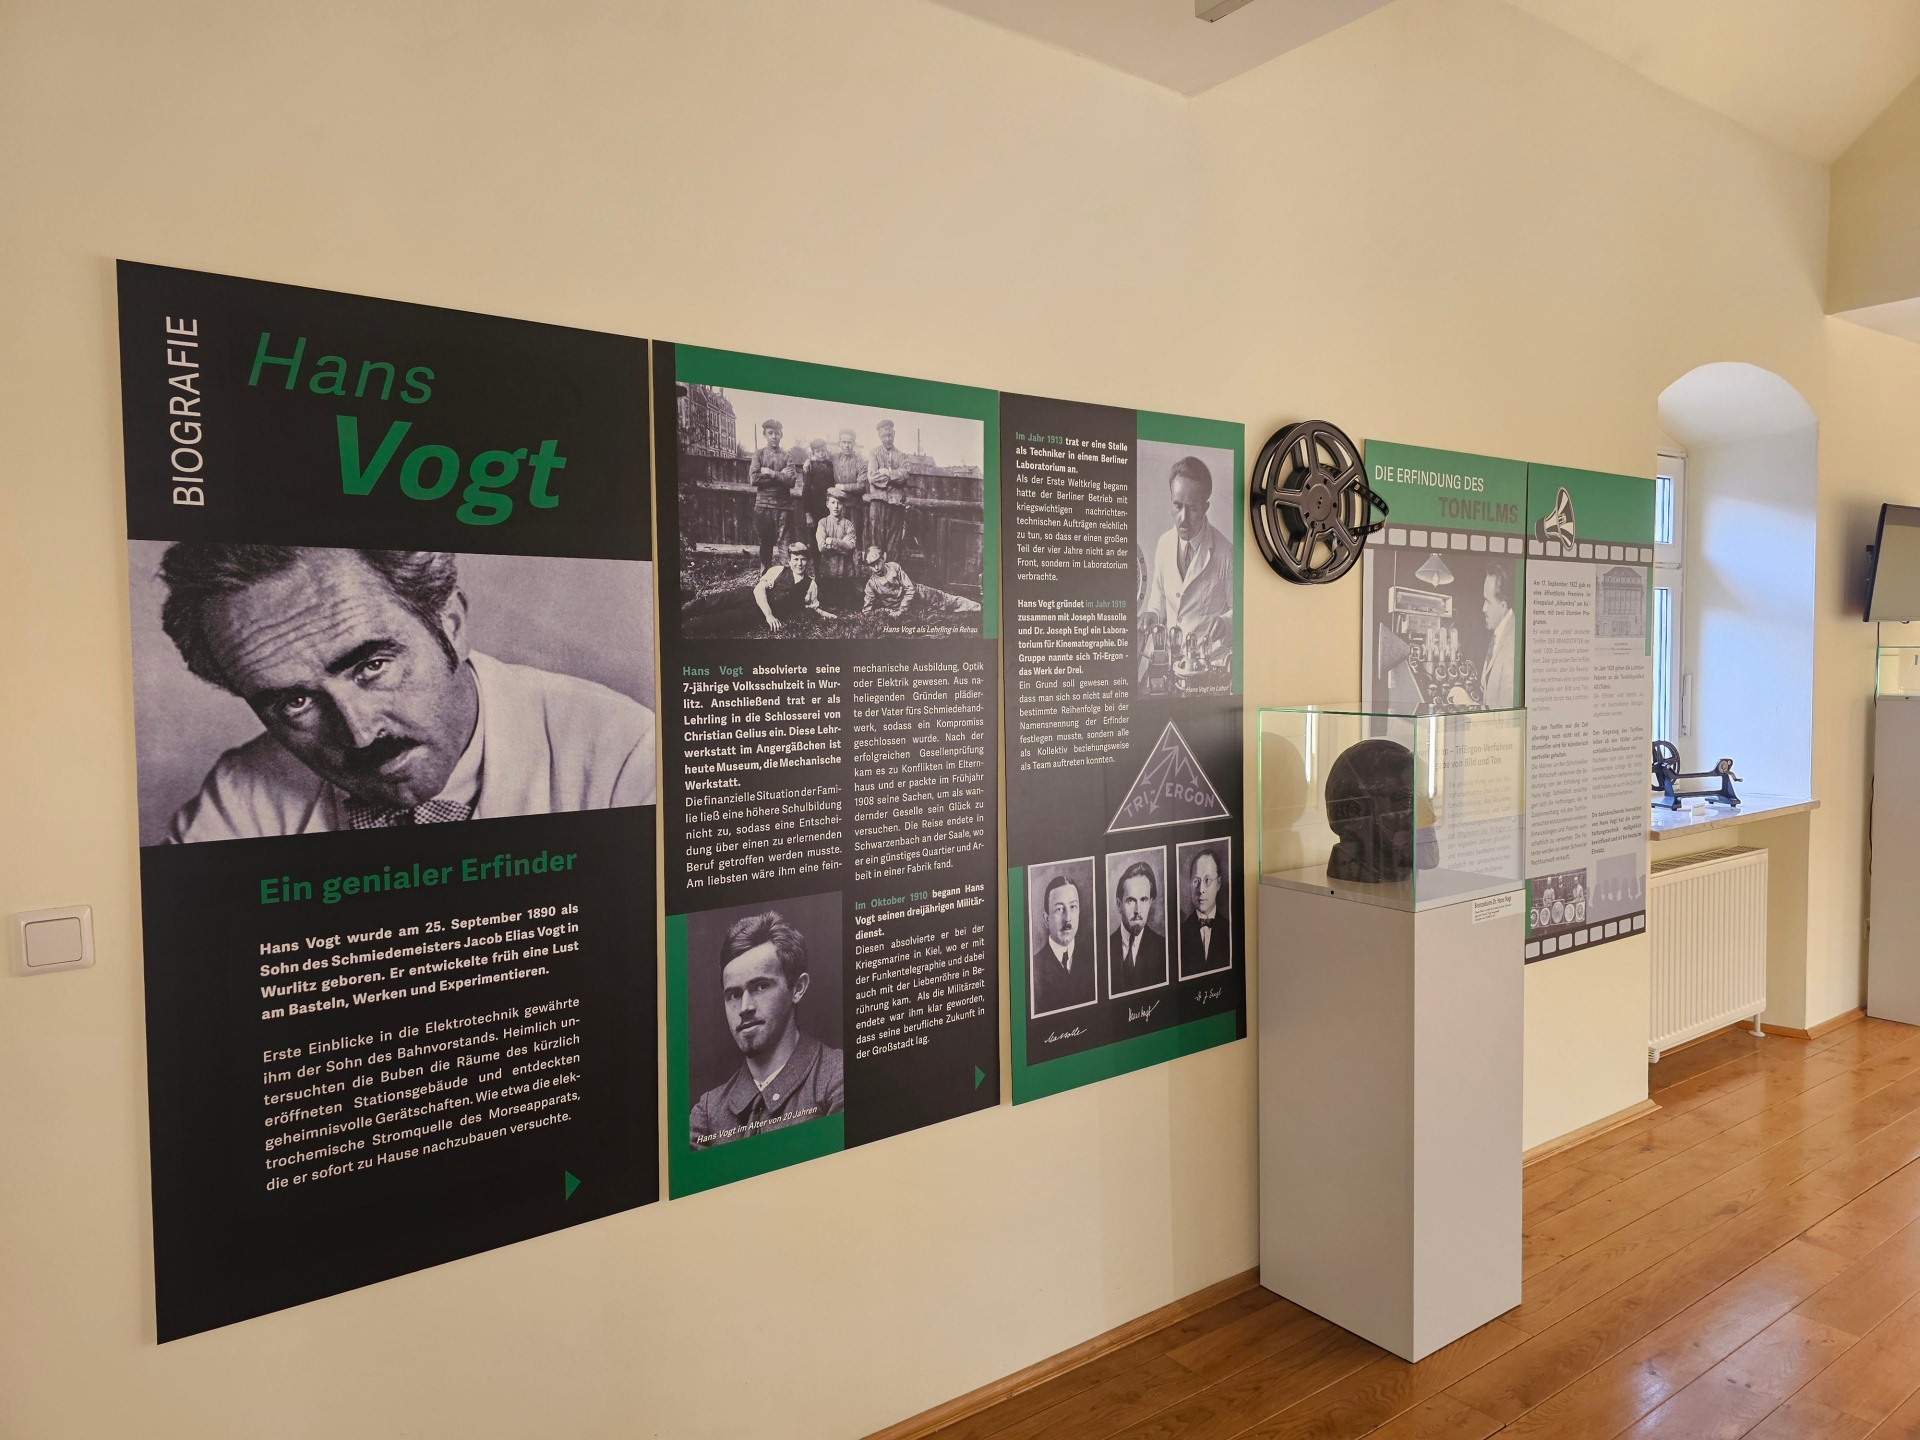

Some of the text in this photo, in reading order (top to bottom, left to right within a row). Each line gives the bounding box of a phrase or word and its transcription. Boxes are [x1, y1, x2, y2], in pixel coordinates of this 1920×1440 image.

[247, 331, 436, 405] Hans
[165, 315, 205, 506] BIOGRAFIE
[1028, 434, 1044, 442] Jahr
[1047, 436, 1062, 444] 1913
[1065, 438, 1078, 446] trat
[1108, 442, 1127, 451] Stelle
[1015, 445, 1128, 465] als Techniker in einem Berliner
[1016, 459, 1078, 474] Laboratorium an.
[335, 414, 568, 527] Vogt
[1375, 465, 1484, 492] DIE ERFINDUNG DES
[1439, 496, 1519, 524] TONFILMS
[1017, 599, 1037, 608] Hans
[1037, 599, 1056, 610] Vogt
[1056, 599, 1085, 610] gründet
[1094, 599, 1111, 608] Jahr
[1111, 600, 1127, 608] 1919
[1017, 612, 1127, 623] zusammen mit Joseph Massolle
[883, 624, 900, 633] Hans
[901, 625, 916, 635] Vogt
[916, 625, 926, 633] als
[926, 625, 952, 635] Lehrling
[959, 625, 978, 633] Rehau
[1018, 625, 1129, 637] und Dr. Joseph Engl ein Labora-
[682, 663, 841, 678] Hans Vogt absolvierte seine
[853, 661, 984, 673] mechanische Ausbildung, Optik
[682, 679, 841, 695] 7-jährige Volksschulzeit in Wur-
[853, 676, 984, 689] oder Elektrik gewesen. Aus na-
[683, 694, 841, 709] litz. Anschließend trat er als
[683, 709, 841, 726] Lehrling in die Schlosserei von
[1465, 756, 1476, 767] Bild
[259, 850, 578, 905] Ein genialer Erfinder
[855, 884, 985, 911] Im Oktober 1910 begann Hans
[854, 896, 985, 926] Vogt seinen dreijährigen Militär-
[259, 903, 579, 956] Hans Vogt wurde am 25. September 1890 als
[855, 927, 885, 941] dienst.
[260, 922, 579, 977] Sohn des Schmiedemeisters Jacob Elias Vogt in
[260, 940, 579, 999] Wurlitz geboren. Er entwickelte früh eine Lust
[261, 966, 550, 1020] am Basteln, Werken und Experimentieren.
[263, 998, 580, 1063] Erste Einblicke in die Elektrotechnik gewährte
[263, 1018, 580, 1085] ihm der Sohn des Bahnvorstands. Heimlich un-
[696, 1106, 818, 1144] Hans Vogt im Alter von 20 Jahren
